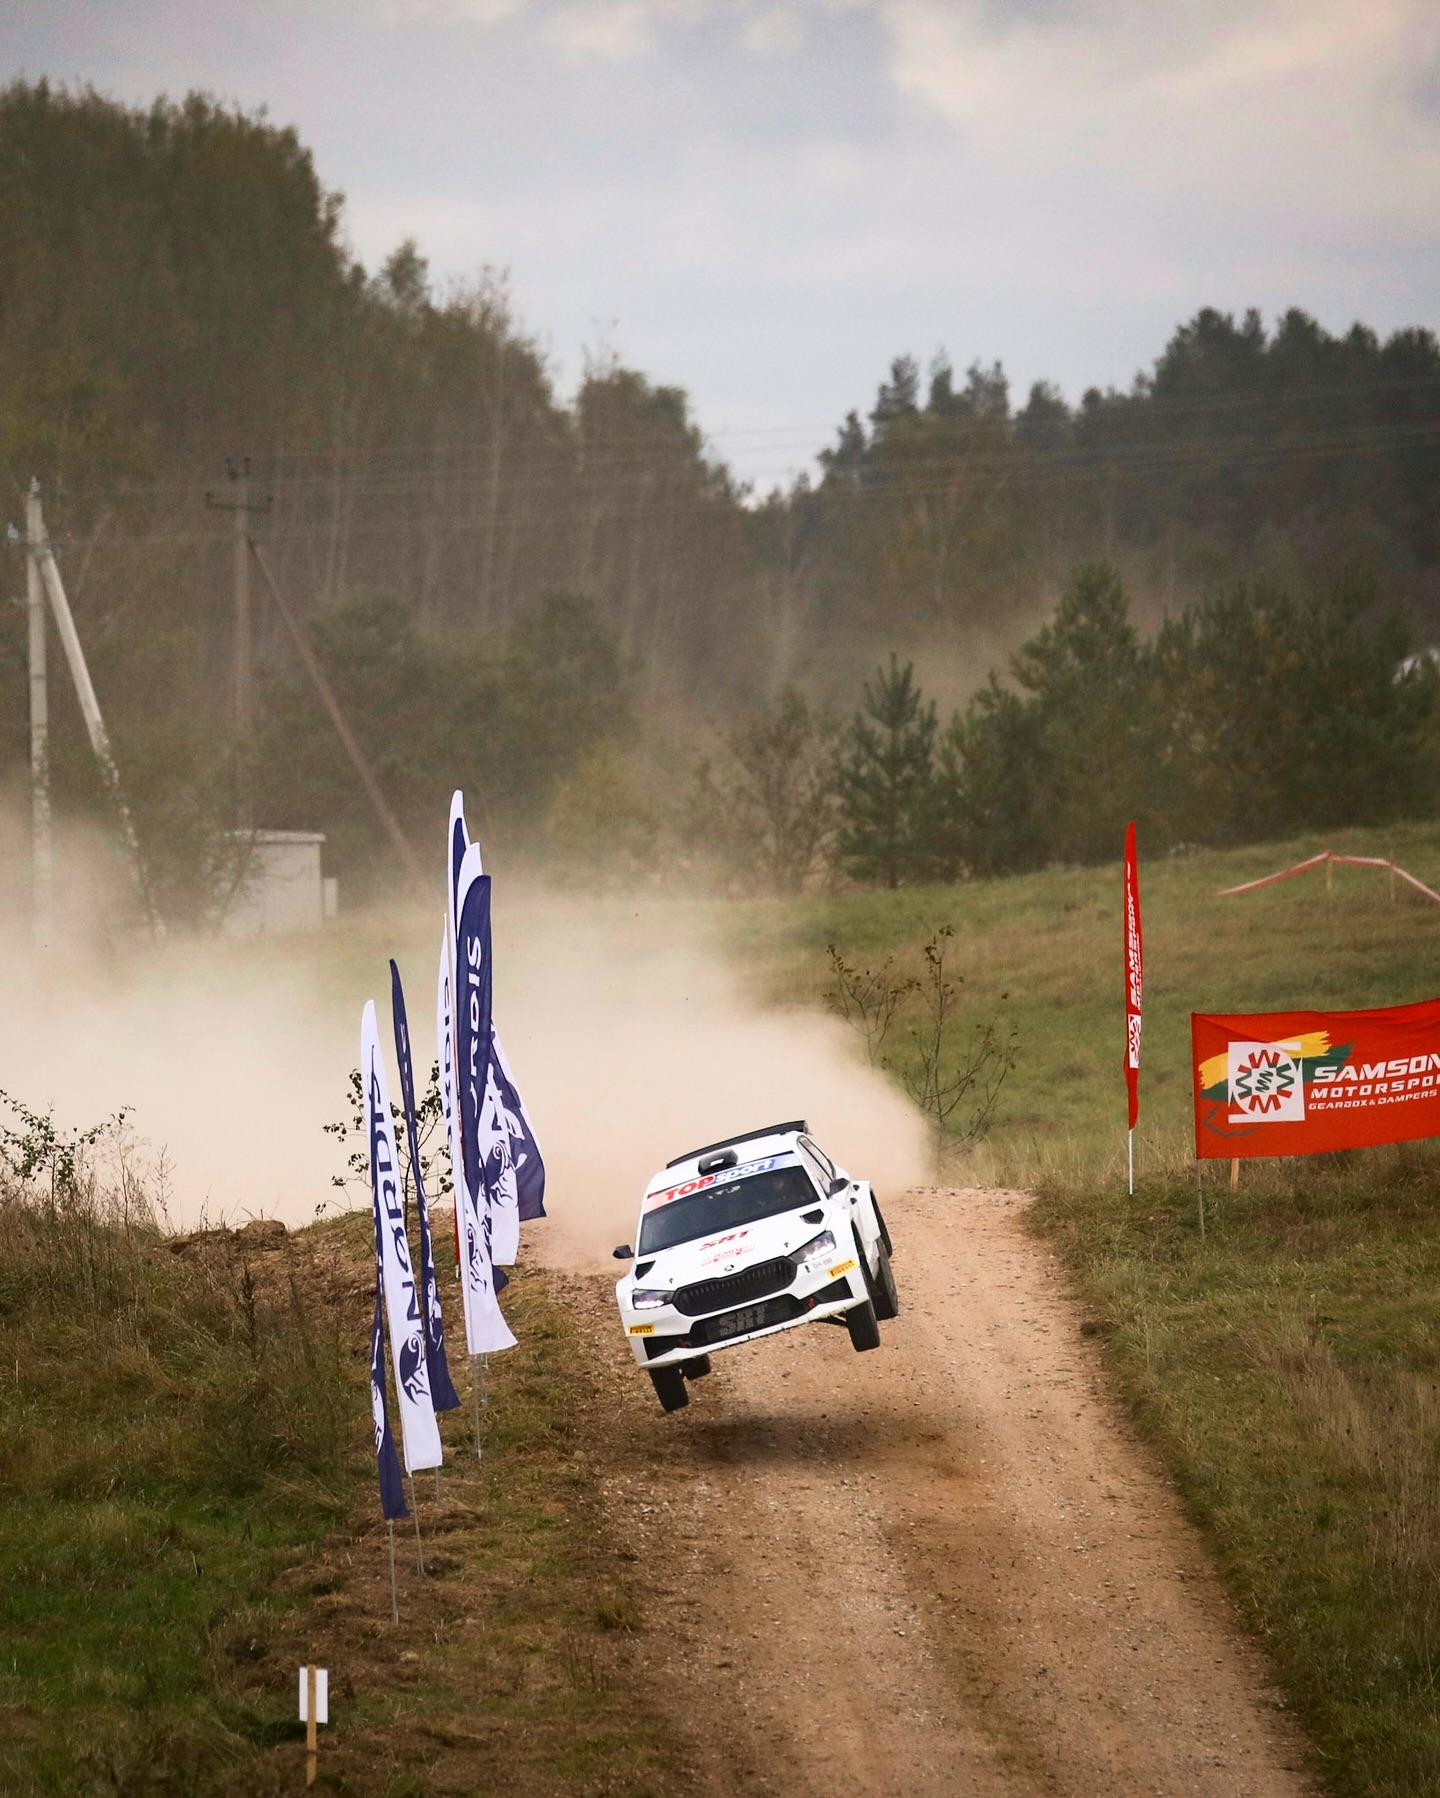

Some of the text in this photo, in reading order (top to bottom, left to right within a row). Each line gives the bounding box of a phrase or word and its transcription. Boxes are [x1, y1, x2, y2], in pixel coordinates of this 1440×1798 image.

[1310, 1074, 1440, 1099] MOTORSPO
[1308, 1099, 1368, 1110] GEARBOX
[1377, 1089, 1438, 1105] DAMPERS
[719, 1304, 768, 1336] SRT
